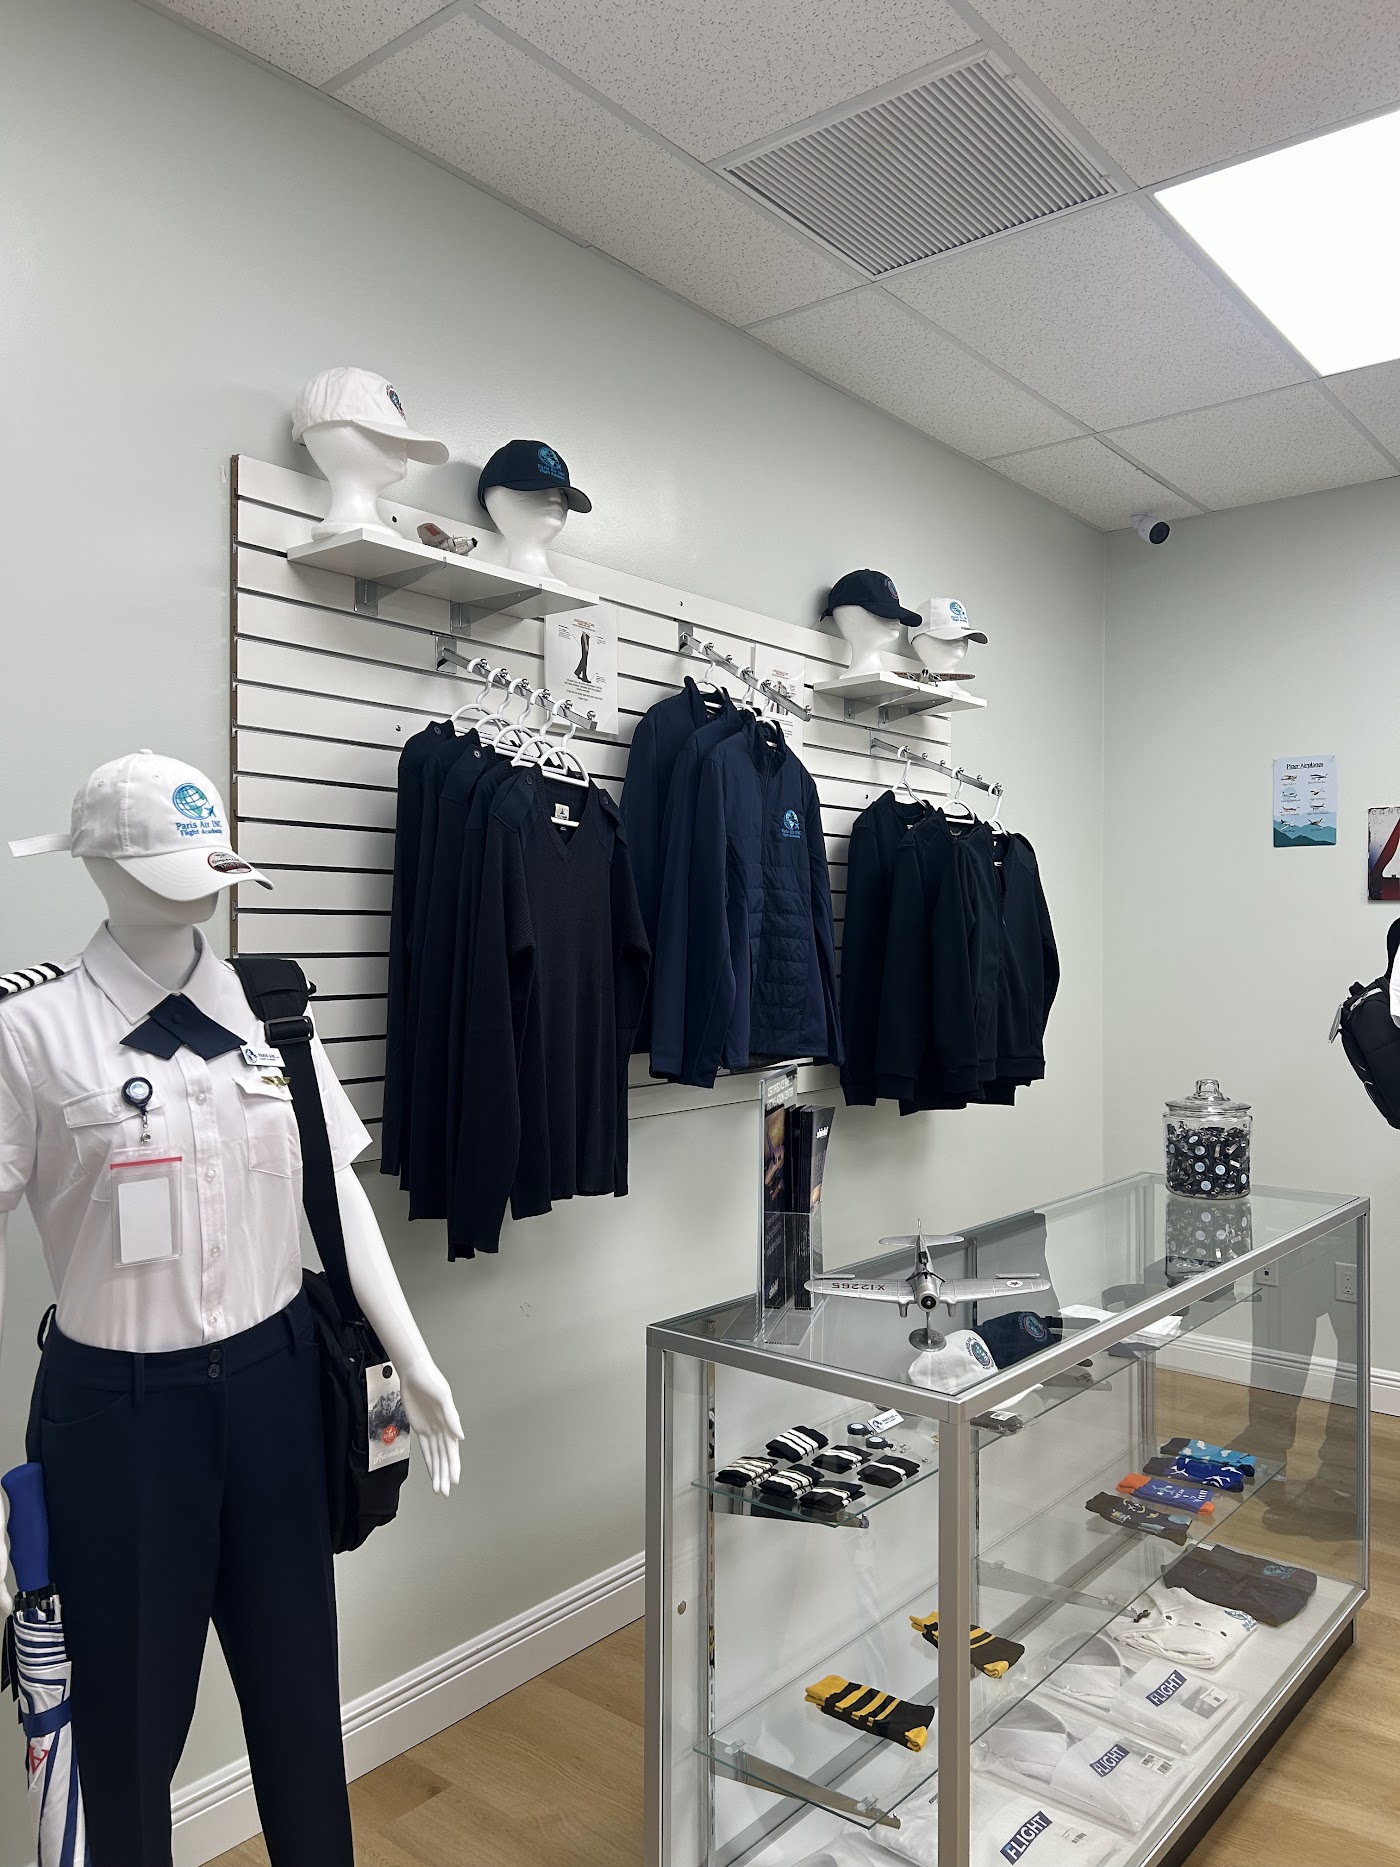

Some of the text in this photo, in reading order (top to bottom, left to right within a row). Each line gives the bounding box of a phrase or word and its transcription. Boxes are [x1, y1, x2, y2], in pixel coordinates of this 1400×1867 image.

[175, 822, 198, 831] Paris
[180, 829, 200, 837] Flight
[1149, 1673, 1182, 1705] FLIGHT
[1092, 1746, 1126, 1776] FLIGHT
[1004, 1815, 1047, 1860] FLIGHT
